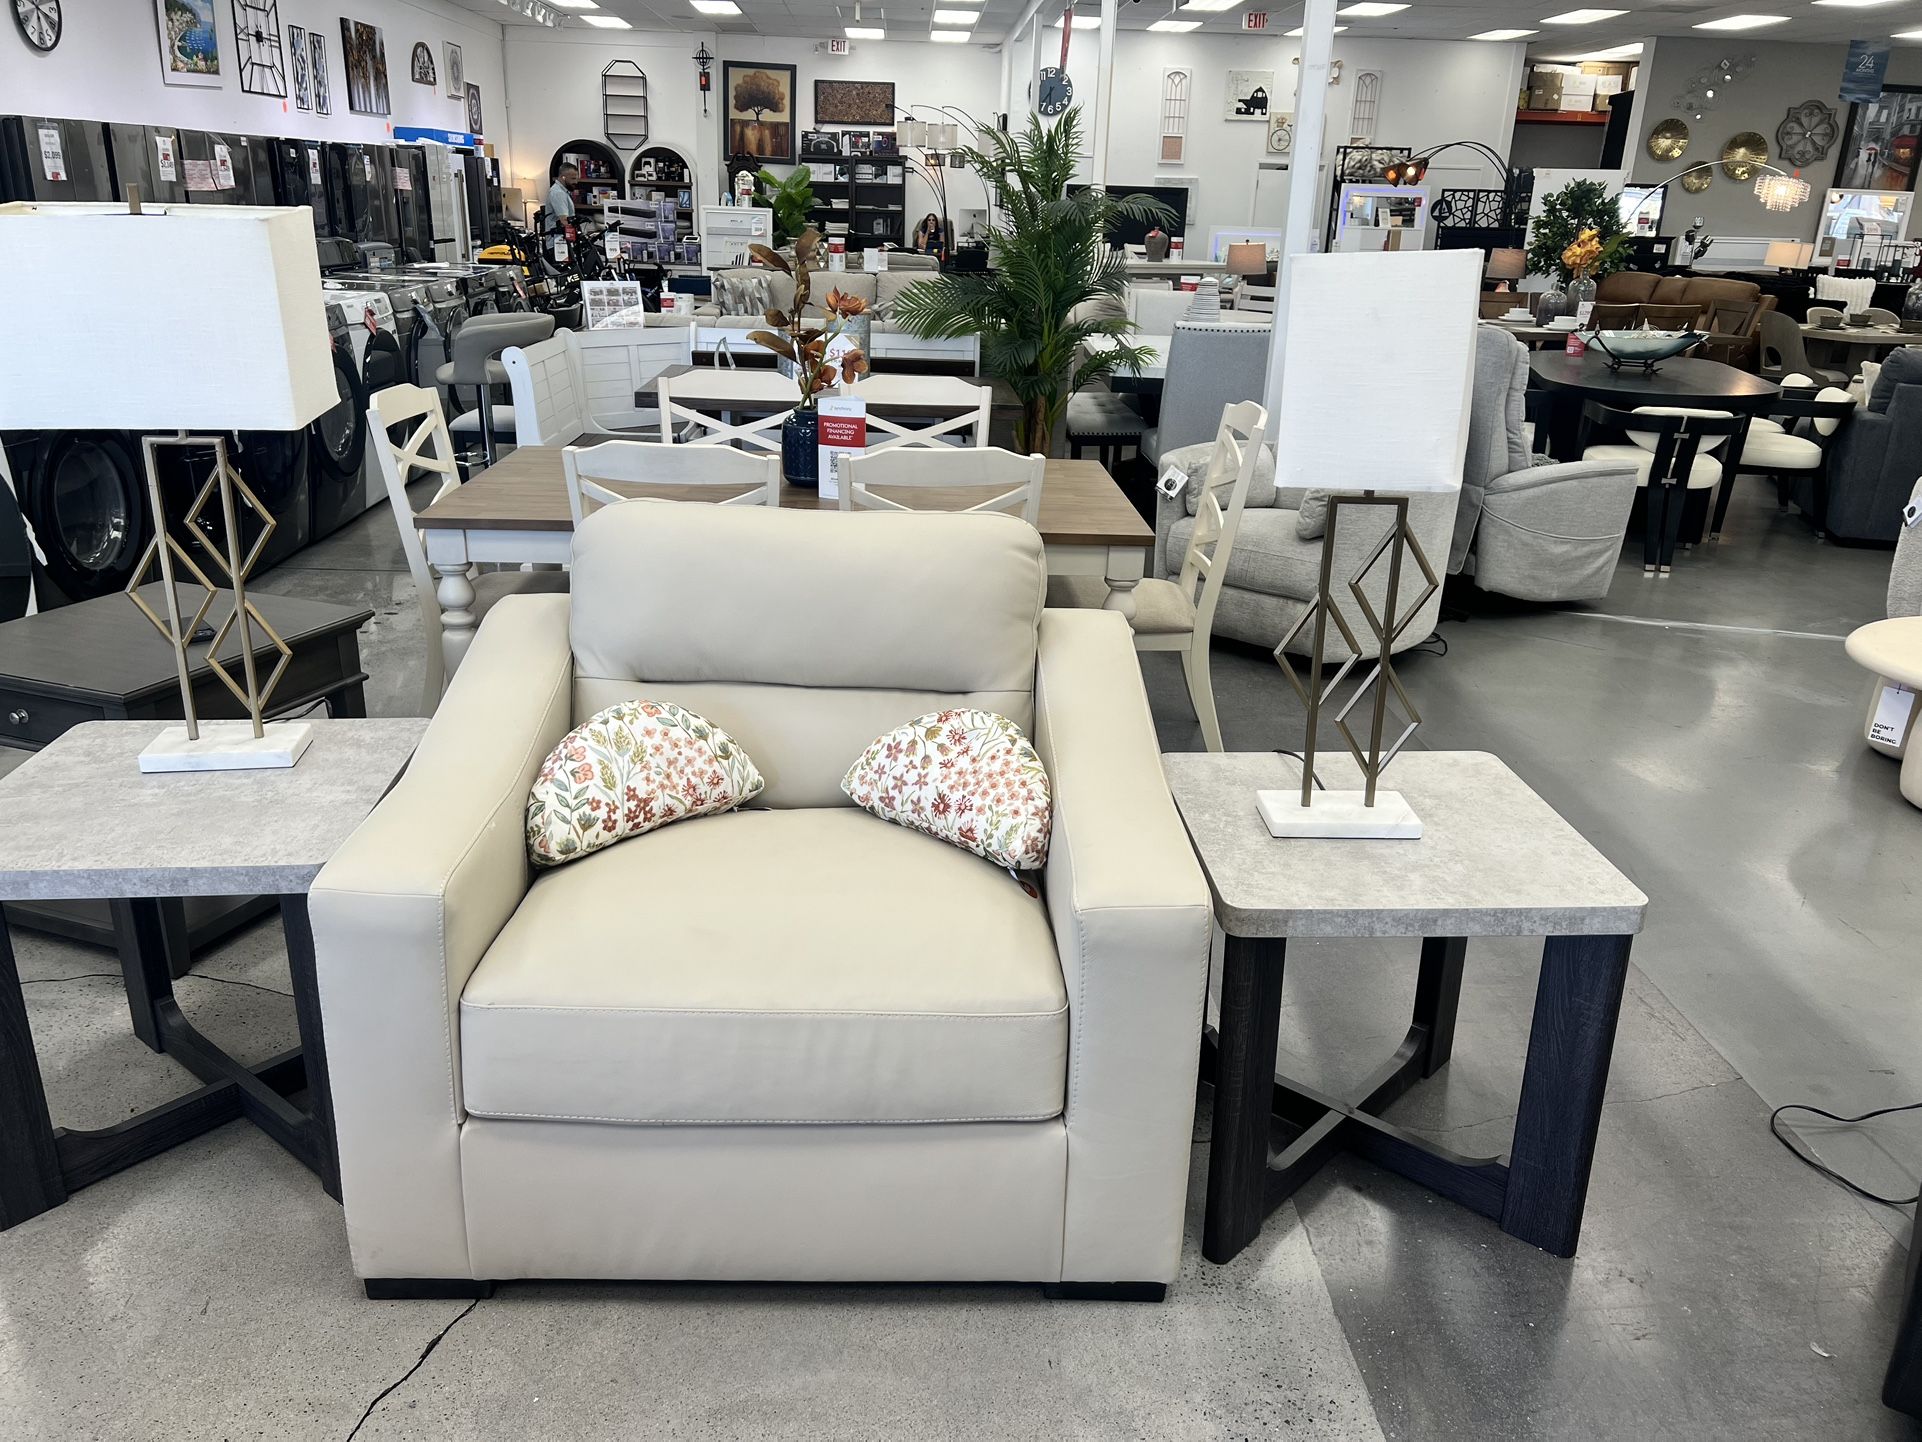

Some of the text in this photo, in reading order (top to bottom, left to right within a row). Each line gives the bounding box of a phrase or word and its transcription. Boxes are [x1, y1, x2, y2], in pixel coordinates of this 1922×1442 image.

[1247, 12, 1267, 29] EXIT
[831, 39, 847, 53] EXIT
[1857, 54, 1874, 69] 24
[1047, 68, 1056, 78] 12
[1062, 75, 1069, 85] 2
[1066, 86, 1073, 96] 3
[1062, 96, 1069, 106] 4
[1040, 102, 1047, 111] 7
[1047, 105, 1054, 114] 6
[1055, 102, 1062, 111] 5
[823, 421, 859, 430] PROMOTIONAL
[1873, 722, 1895, 732] DON'T
[1870, 733, 1897, 745] BORING
